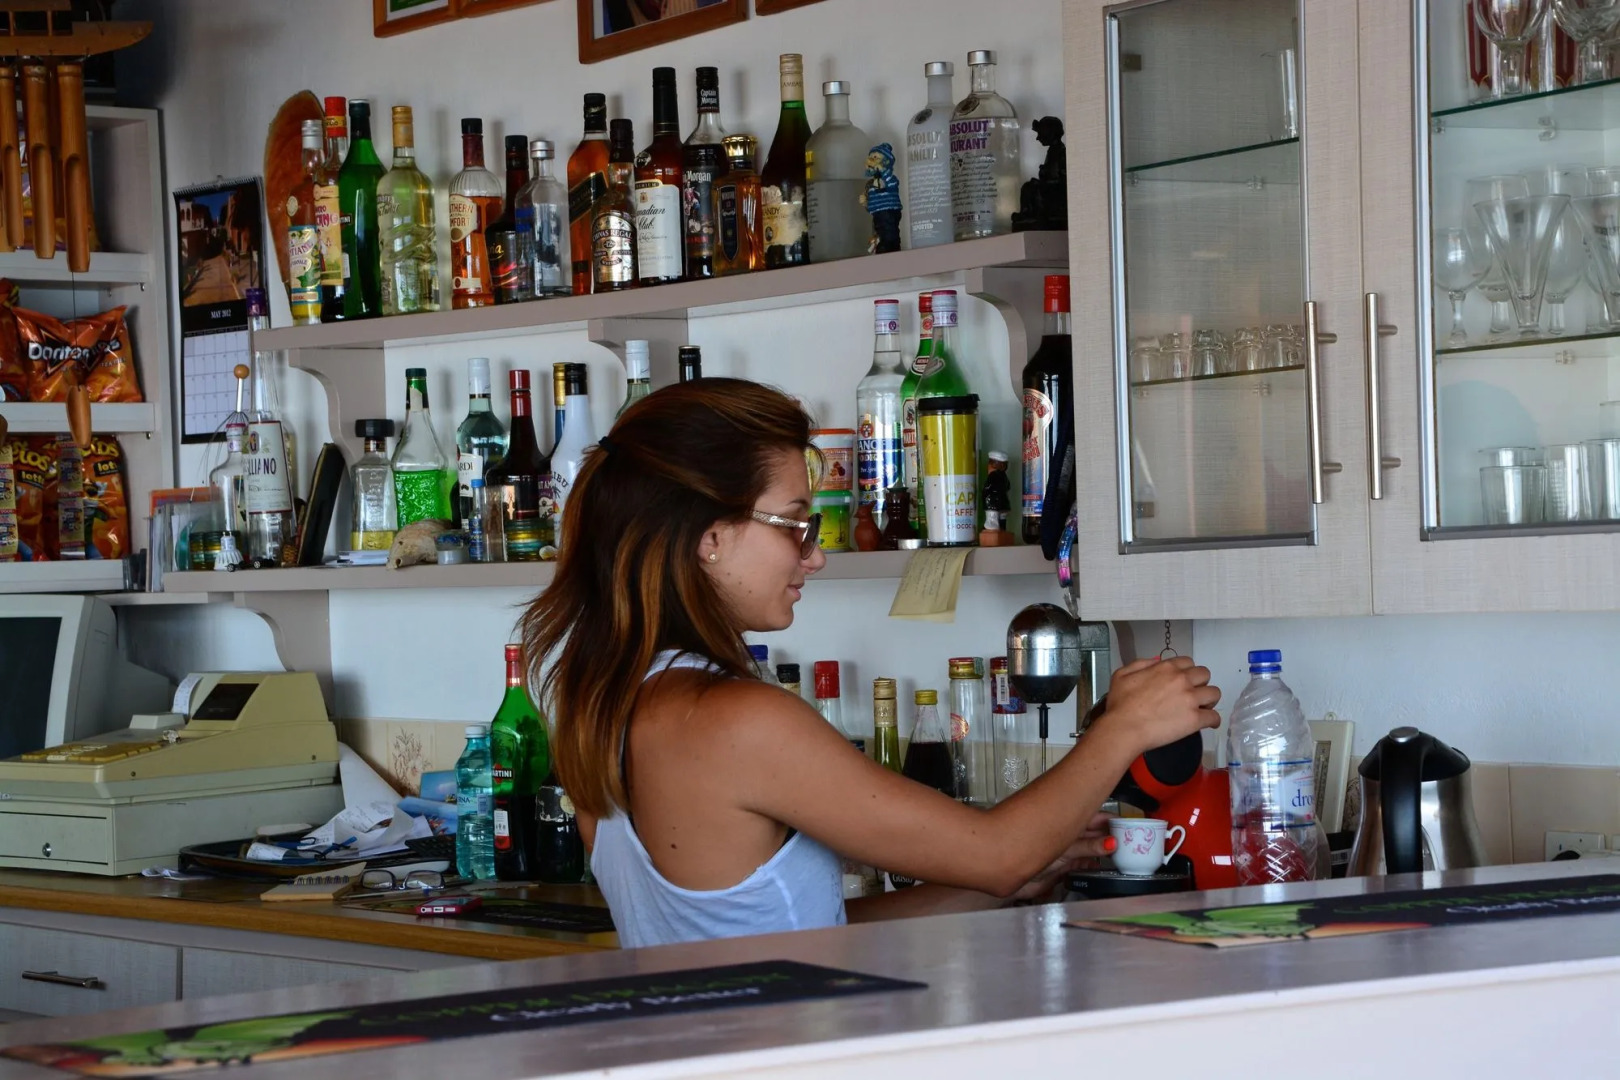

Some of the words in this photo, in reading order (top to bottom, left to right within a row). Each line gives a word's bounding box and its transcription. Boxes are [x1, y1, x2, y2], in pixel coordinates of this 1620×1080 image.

[701, 89, 717, 97] Captain
[686, 170, 712, 183] Morgan
[636, 204, 666, 216] nadian
[610, 229, 633, 240] REGAL
[211, 310, 221, 319] MAY
[493, 770, 513, 779] ARTINI
[1291, 788, 1314, 808] dro
